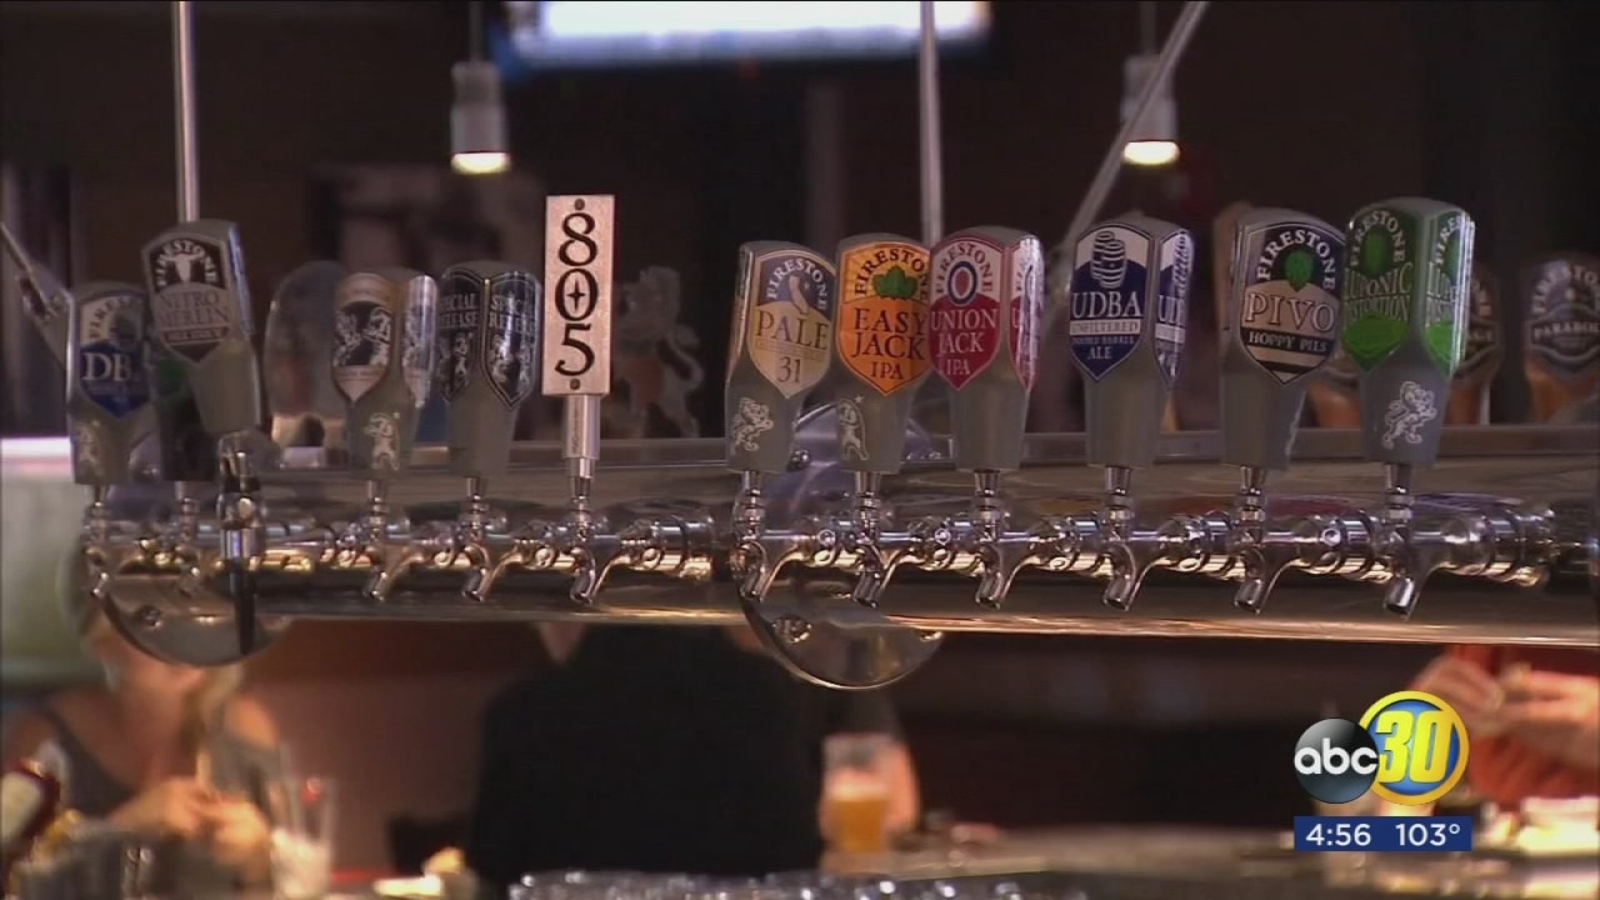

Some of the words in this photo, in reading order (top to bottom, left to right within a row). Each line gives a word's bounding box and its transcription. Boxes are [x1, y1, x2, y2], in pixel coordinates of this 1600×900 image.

[935, 240, 994, 294] FIRESTONE
[1257, 229, 1336, 290] FIRESTONE
[554, 212, 599, 376] 805
[767, 257, 828, 310] FIRESTONE
[160, 289, 220, 308] NITRO
[1072, 291, 1145, 319] UDBA
[1244, 293, 1335, 332] PIVO
[755, 309, 829, 350] PALE
[853, 307, 927, 335] EASY
[931, 308, 999, 331] UNION
[851, 331, 925, 359] JACK
[937, 332, 985, 357] JACK
[1087, 345, 1113, 360] ALE
[1249, 331, 1295, 349] HOPPY
[1301, 337, 1328, 353] PILS
[777, 356, 800, 383] 31
[871, 361, 904, 380] IPA
[947, 358, 970, 376] IPA
